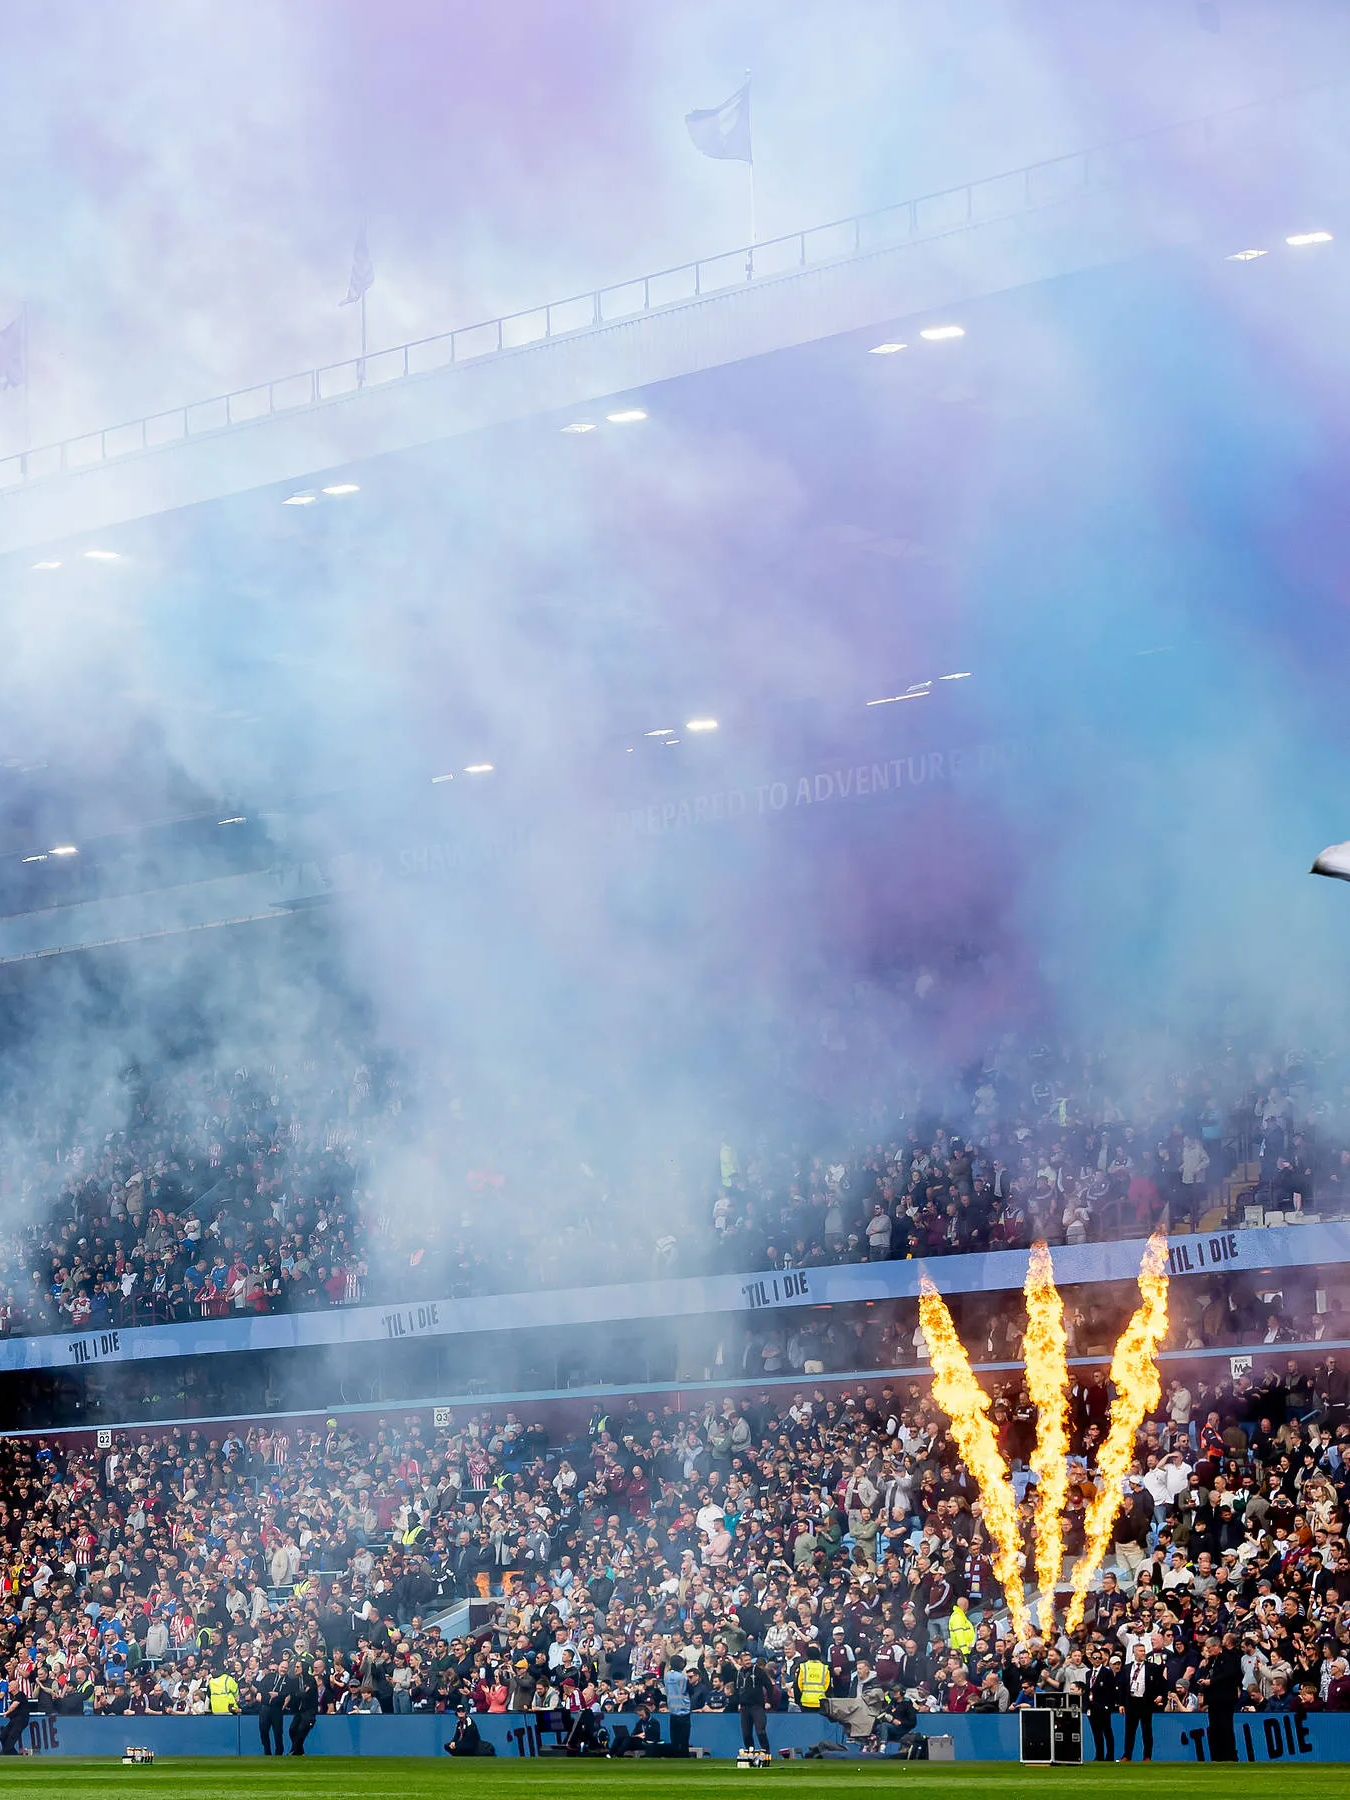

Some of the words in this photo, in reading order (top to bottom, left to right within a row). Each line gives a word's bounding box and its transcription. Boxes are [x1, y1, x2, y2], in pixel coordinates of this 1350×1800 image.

[614, 789, 747, 835] PREPARED
[753, 781, 789, 815] TO
[794, 748, 965, 807] ADVENTURE
[1169, 1245, 1195, 1274] TIL
[1197, 1242, 1205, 1267] I
[1209, 1233, 1239, 1263] DIE
[741, 1281, 770, 1309] 'TIL
[773, 1279, 780, 1302] I
[783, 1271, 809, 1299] DIE
[381, 1312, 407, 1338] 'TIL
[408, 1311, 415, 1332] I
[417, 1303, 439, 1329] DIE
[68, 1340, 91, 1364] 'TIL
[93, 1338, 98, 1358] I
[100, 1331, 120, 1355] DIE
[1234, 1363, 1249, 1374] M
[436, 1413, 448, 1422] Q3
[99, 1435, 110, 1444] Q2
[29, 1715, 59, 1752] DIE
[1242, 1723, 1256, 1762] I
[1263, 1711, 1313, 1760] DIE
